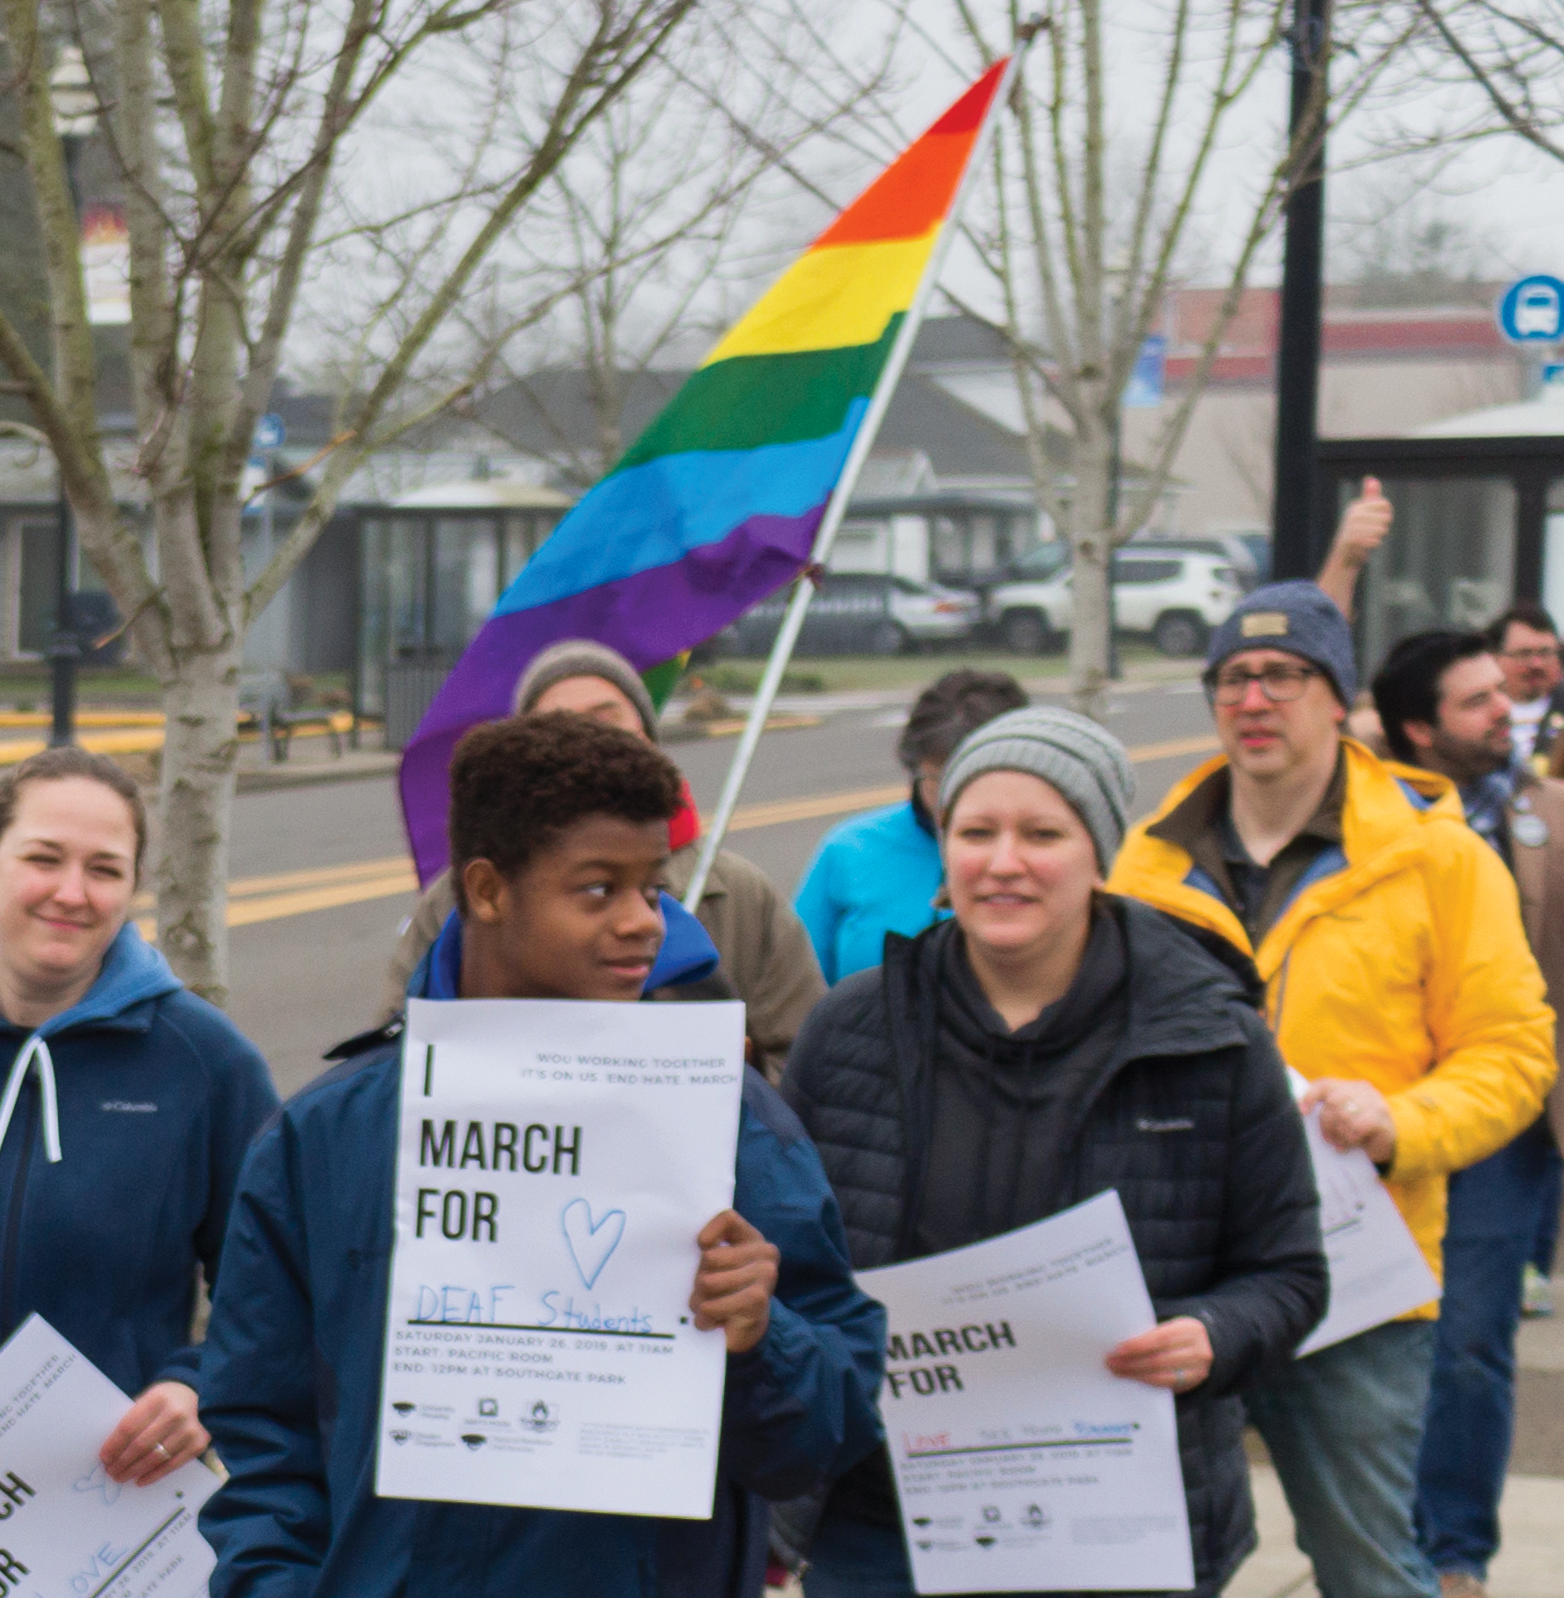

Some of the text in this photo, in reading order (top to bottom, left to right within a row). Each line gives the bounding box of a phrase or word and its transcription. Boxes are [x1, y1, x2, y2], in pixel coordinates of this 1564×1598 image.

[423, 1044, 434, 1096] I
[537, 1053, 726, 1068] WOU WORKING TOGETHER
[521, 1070, 546, 1079] IT'S
[553, 1071, 572, 1081] ON
[608, 1074, 637, 1084] END
[690, 1075, 738, 1084] MARCH
[420, 1119, 582, 1175] MARCH
[416, 1189, 499, 1242] FOR
[417, 1286, 652, 1332] DEAF Students
[395, 1331, 471, 1342] SATURDAY
[477, 1334, 545, 1347] JANUARY
[617, 1342, 635, 1352] AT
[640, 1344, 673, 1354] 11AM
[449, 1350, 505, 1361] PACIFIC
[510, 1353, 553, 1362] ROOM
[432, 1364, 467, 1374] 12PM
[473, 1367, 490, 1376] AT
[495, 1367, 582, 1382] SOUTHGATE
[588, 1374, 626, 1384] PARK
[887, 1364, 964, 1399] FOR
